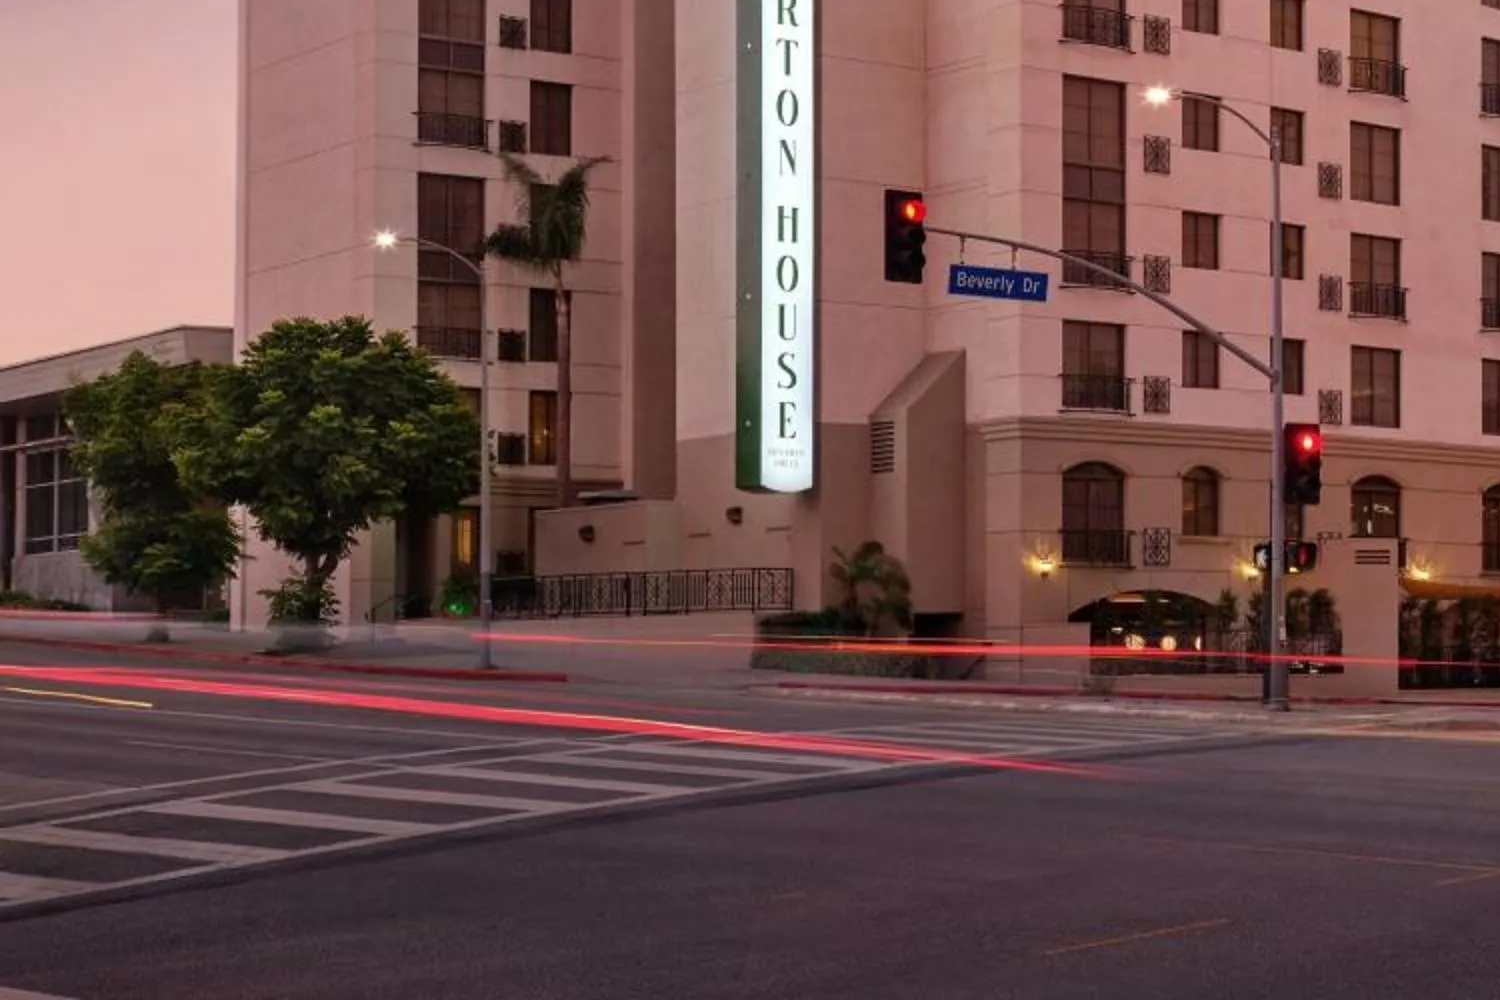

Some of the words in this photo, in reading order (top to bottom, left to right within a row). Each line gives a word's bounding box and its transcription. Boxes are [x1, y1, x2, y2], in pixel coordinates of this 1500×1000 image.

[775, 205, 799, 440] HOUSE
[957, 271, 1015, 295] Beverly
[1022, 277, 1041, 294] Dr
